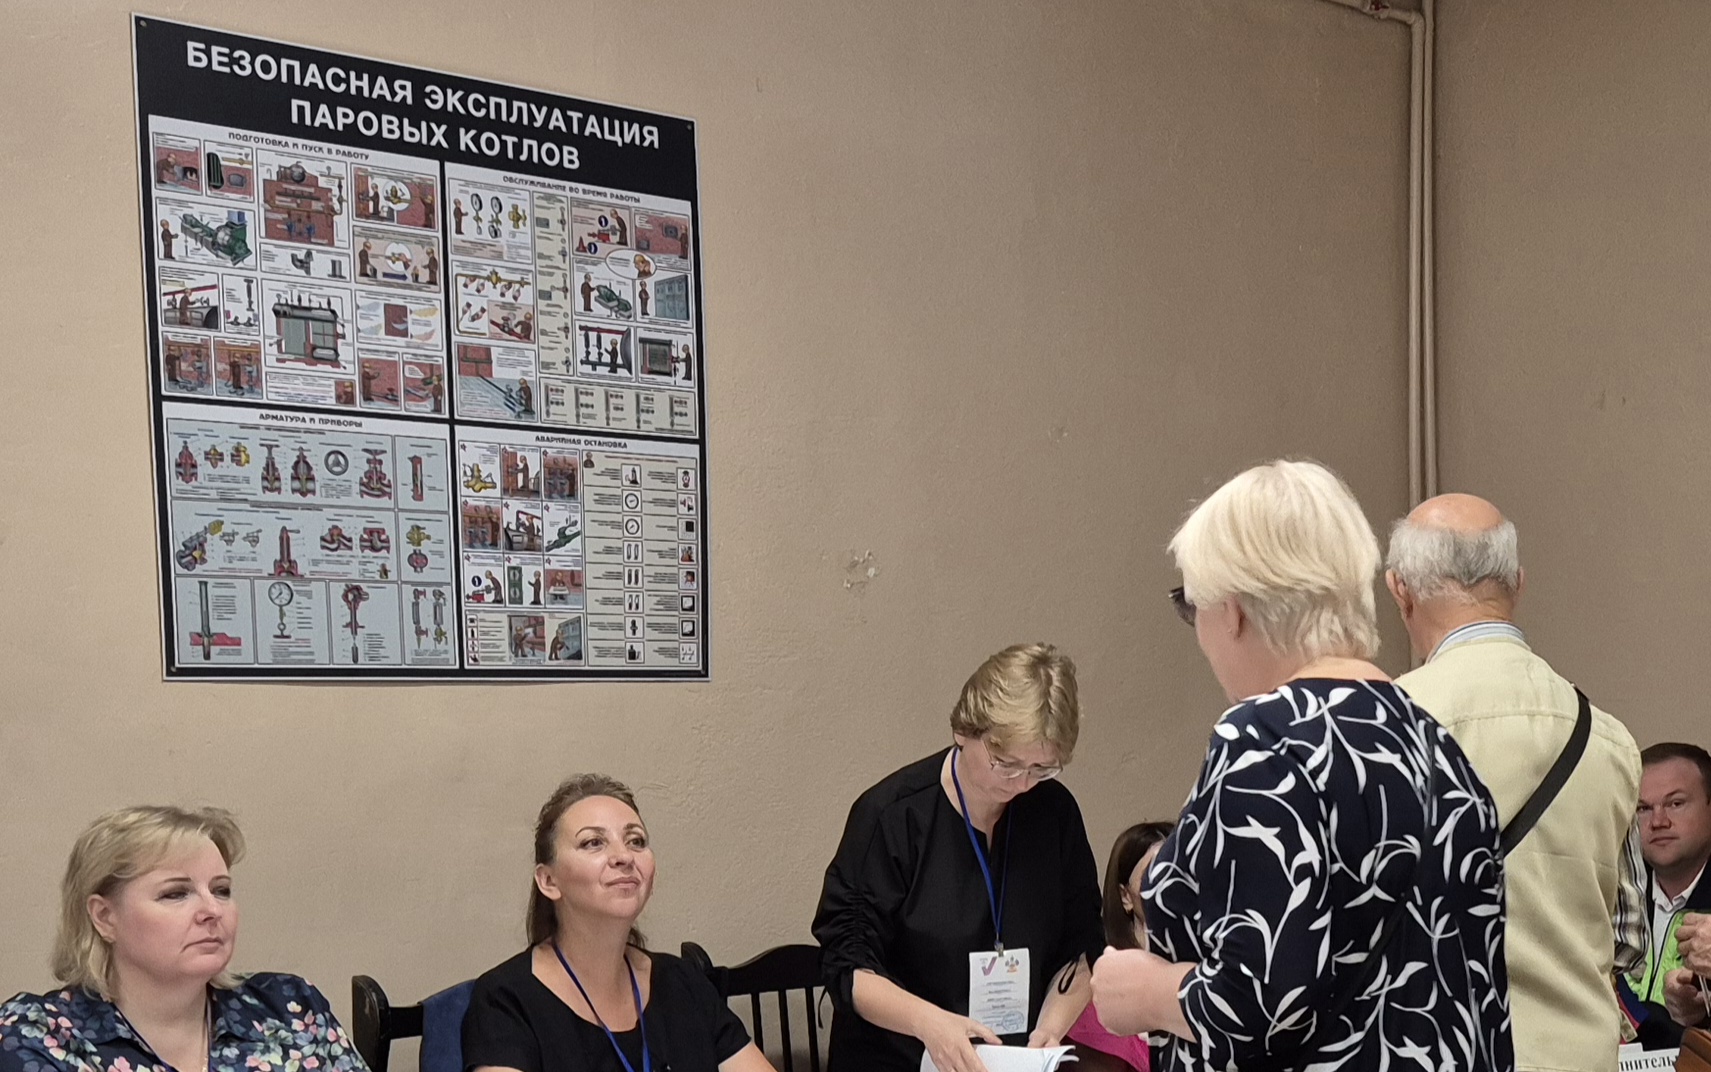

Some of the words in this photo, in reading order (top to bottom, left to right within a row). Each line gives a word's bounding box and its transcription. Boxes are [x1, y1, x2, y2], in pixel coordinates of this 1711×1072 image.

[187, 41, 413, 104] БЕЗОПАСНАЯ
[424, 85, 659, 149] ЭКСПЛУАТАЦИЯ
[228, 132, 289, 149] ПОДГОТОВКА
[302, 144, 325, 153] ПУСК
[335, 149, 370, 161] РАБОТУ
[291, 99, 447, 148] ПАРОВЫХ
[459, 129, 580, 170] КОТЛОВ
